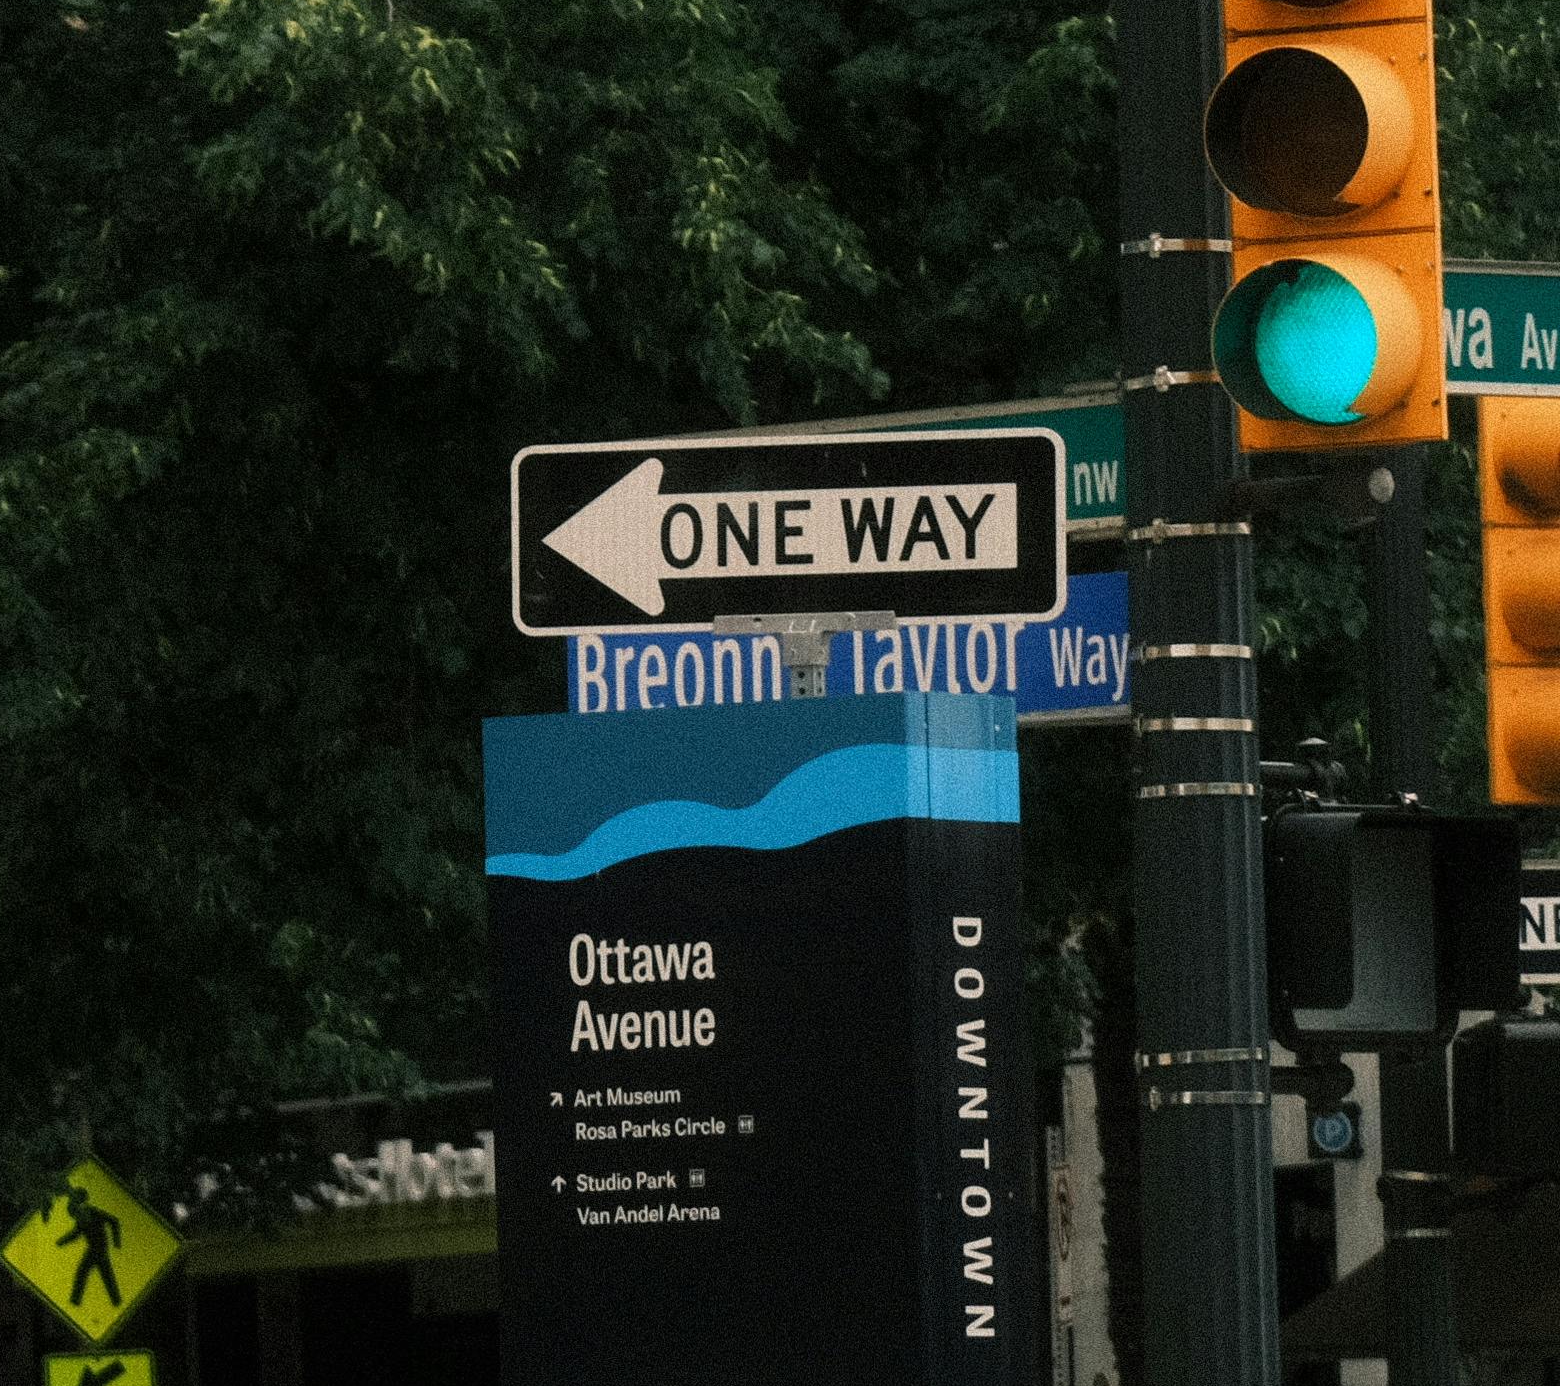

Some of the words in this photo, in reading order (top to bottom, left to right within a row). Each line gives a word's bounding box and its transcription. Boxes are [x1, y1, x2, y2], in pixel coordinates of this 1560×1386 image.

[1073, 459, 1119, 506] nw
[660, 502, 814, 570] ONE
[840, 493, 996, 564] WAY
[577, 634, 782, 714] Breonn
[1049, 625, 1130, 702] Way
[569, 932, 716, 987] Ottawa
[570, 1000, 716, 1053] Avenue
[574, 1088, 603, 1108] Art
[607, 1087, 681, 1107] Museum
[575, 1121, 617, 1141] Rosa
[621, 1119, 670, 1139] Parks
[675, 1116, 726, 1138] Circle
[952, 916, 996, 1337] DOWNTOWN
[576, 1172, 632, 1193] Studio
[636, 1170, 677, 1190] Park
[577, 1206, 610, 1226] Van
[614, 1204, 663, 1225] Andel
[667, 1203, 720, 1223] Arena
